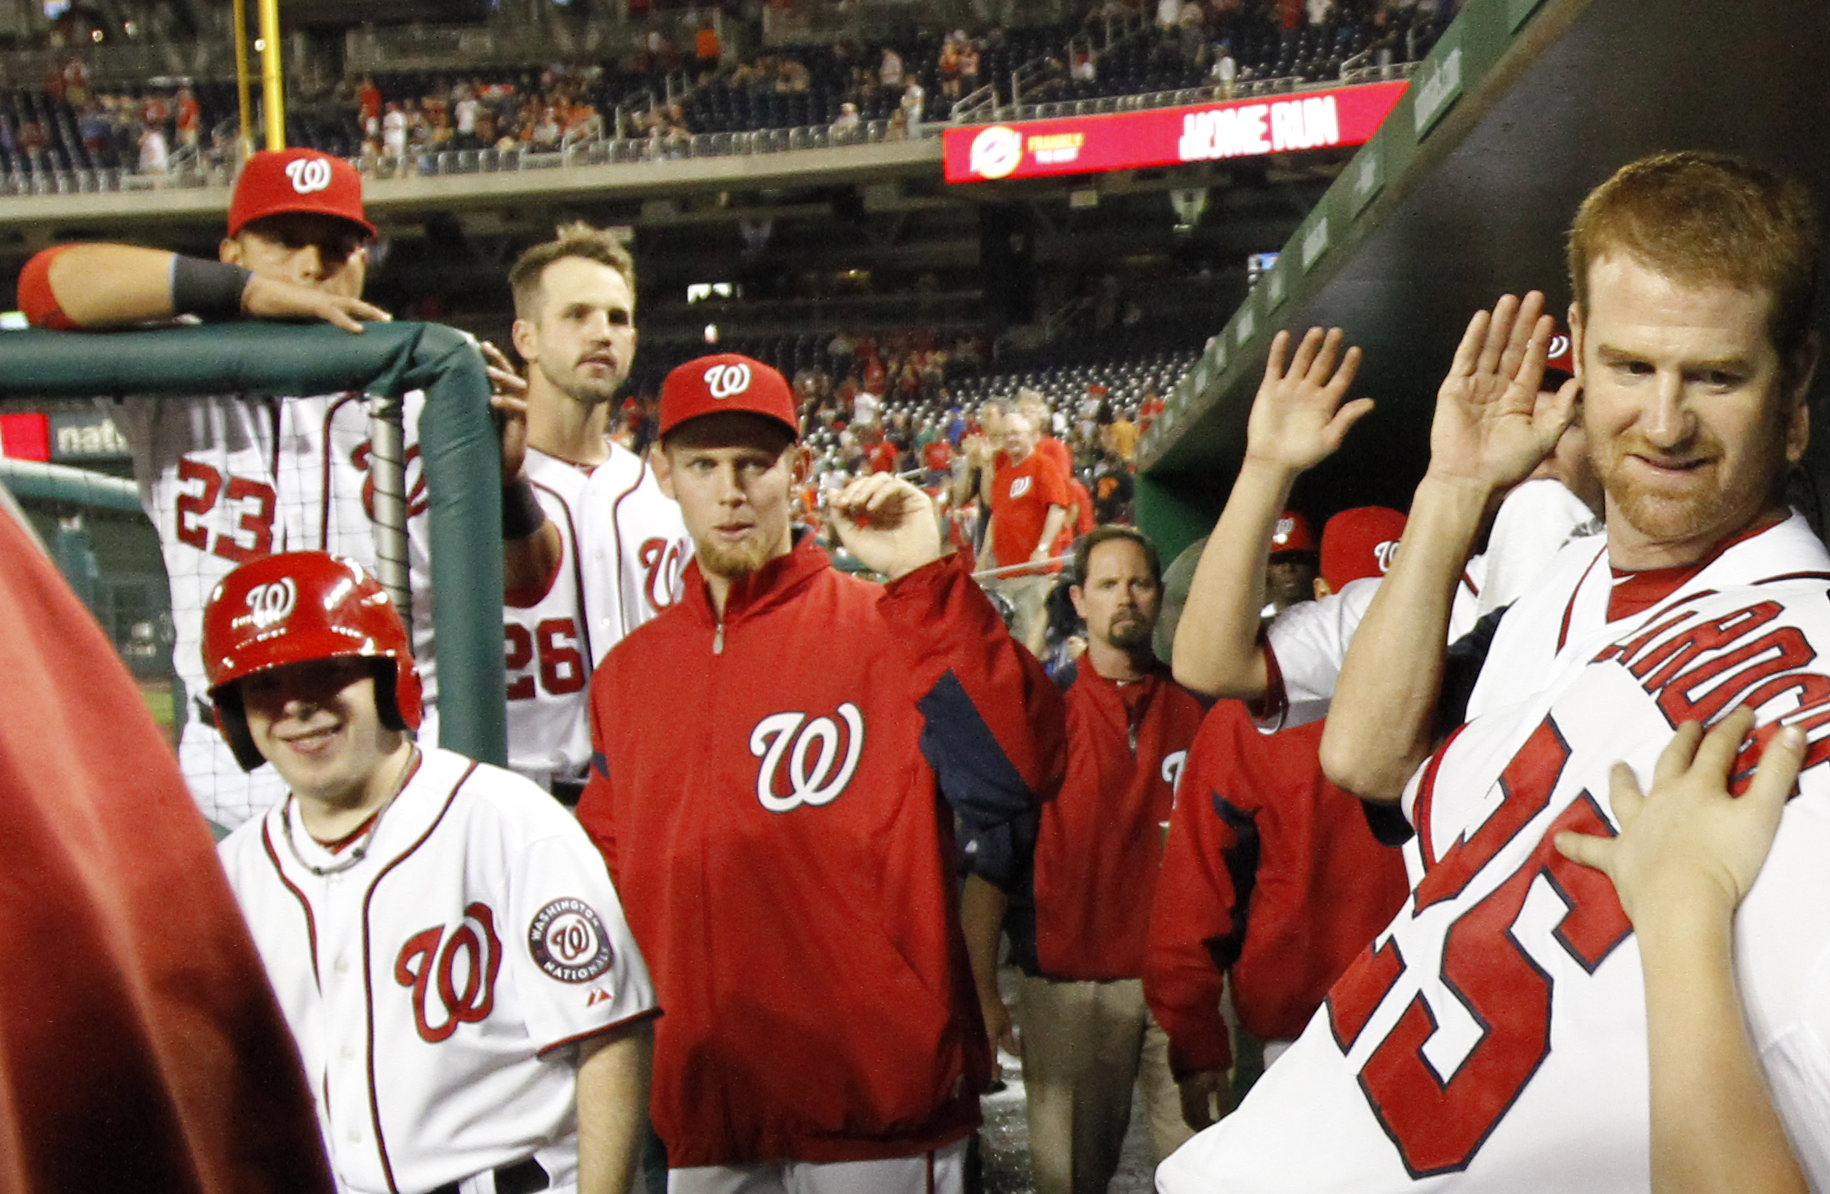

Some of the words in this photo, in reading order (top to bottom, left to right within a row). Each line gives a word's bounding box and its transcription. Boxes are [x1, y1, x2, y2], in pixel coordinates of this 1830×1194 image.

[1271, 95, 1339, 151] RUN
[285, 157, 332, 194] W
[703, 362, 751, 399] W
[176, 456, 277, 565] 23
[245, 576, 297, 629] W
[503, 618, 586, 700] 26
[749, 702, 866, 812] W
[530, 899, 600, 941] WASHINGTON
[393, 901, 503, 1044] W
